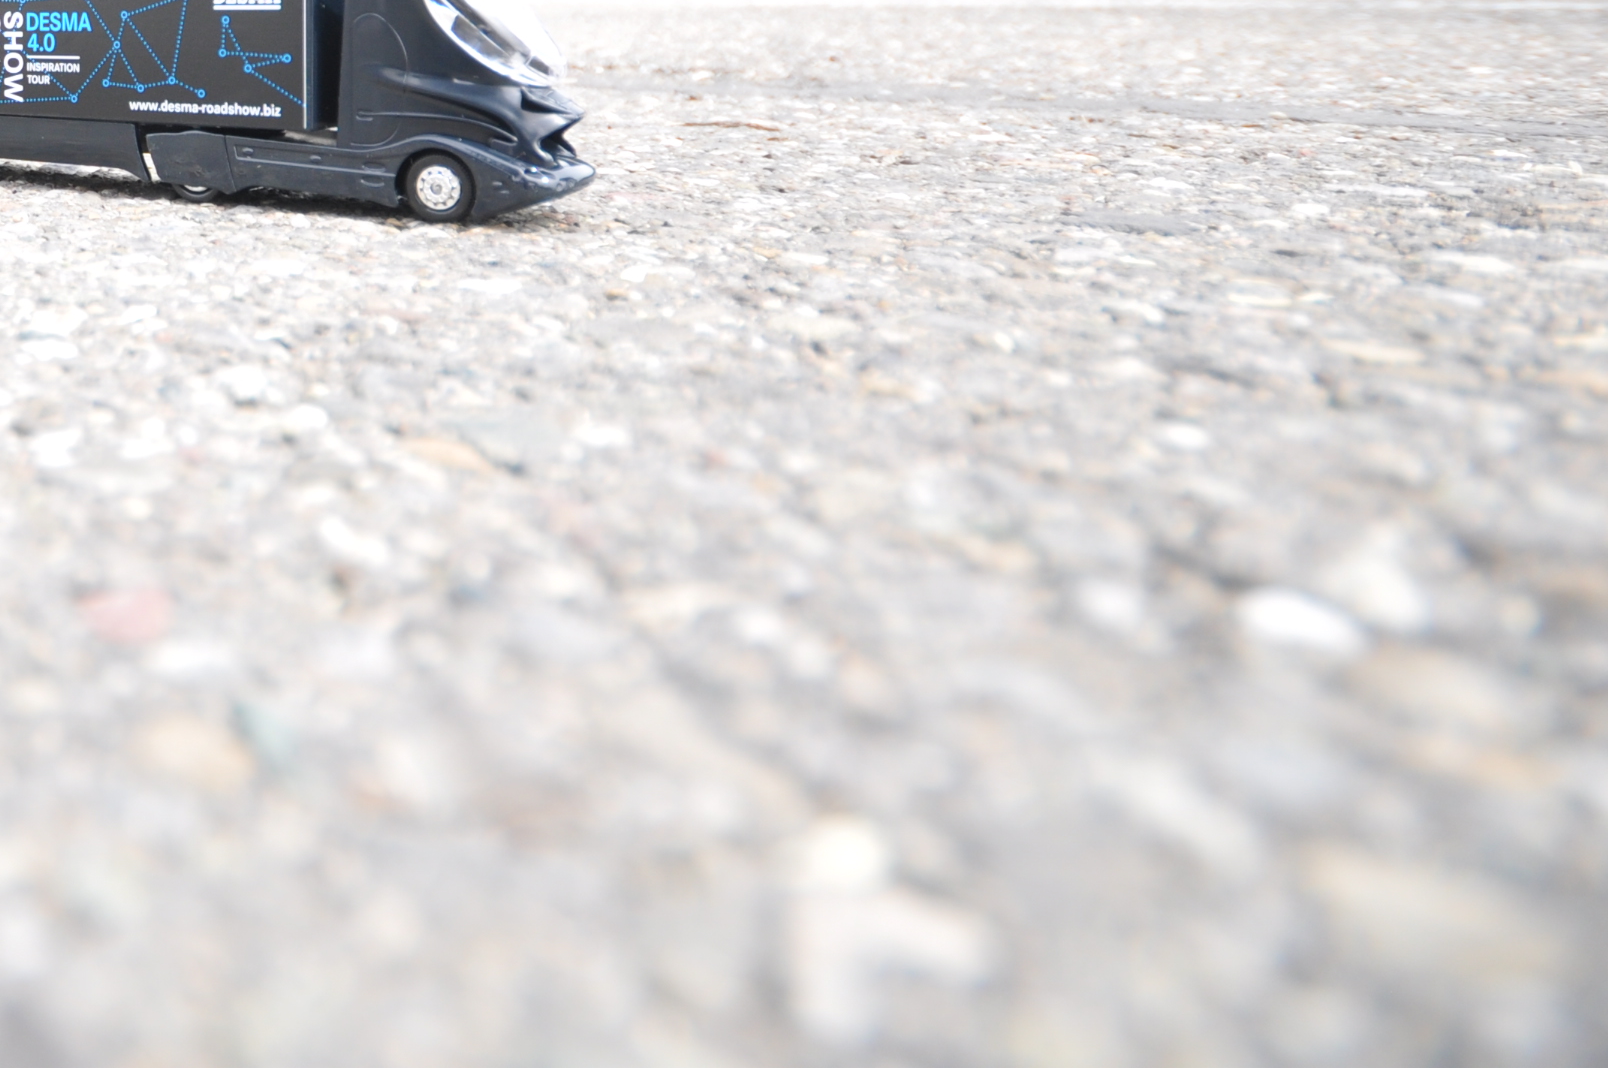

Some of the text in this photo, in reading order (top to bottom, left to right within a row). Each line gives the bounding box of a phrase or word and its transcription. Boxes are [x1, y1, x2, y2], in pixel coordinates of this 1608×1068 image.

[26, 12, 92, 32] DESMA
[27, 33, 56, 52] 4.0
[4, 11, 24, 102] SHOW
[26, 62, 80, 73] INSPIRATION
[27, 75, 51, 85] TOUR
[129, 99, 281, 117] www.desma-roadshow.biz
